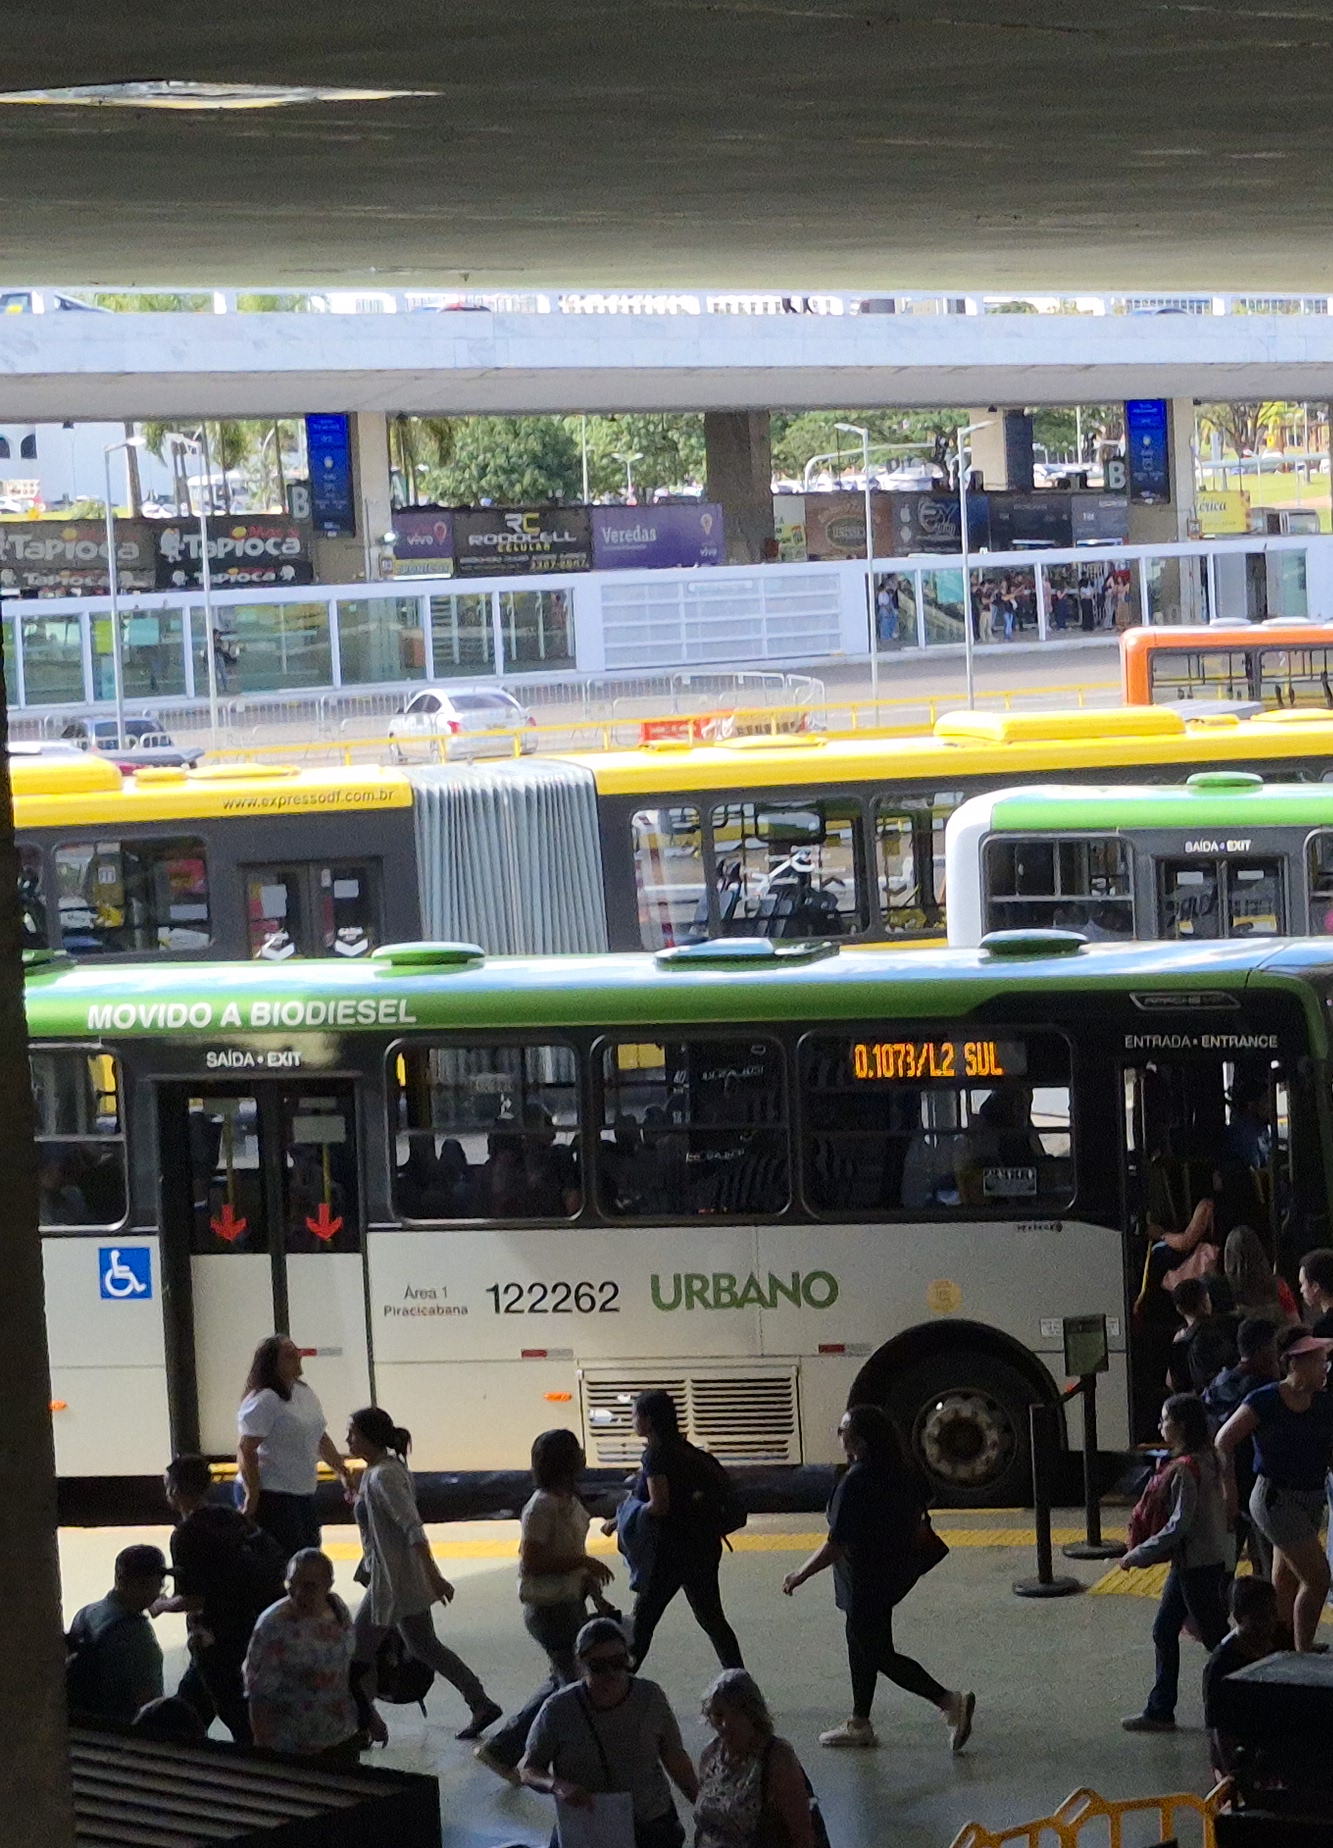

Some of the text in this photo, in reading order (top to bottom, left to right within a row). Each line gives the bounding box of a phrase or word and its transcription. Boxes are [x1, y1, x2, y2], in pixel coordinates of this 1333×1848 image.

[1109, 461, 1126, 489] B
[291, 486, 310, 519] B
[602, 525, 657, 543] Veredas
[222, 788, 394, 810] www.expressodf.com.br
[1185, 839, 1251, 853] SAÍDA EXIT
[88, 999, 418, 1031] MOVIDO A BIODIESEL
[1124, 1034, 1278, 1048] ENTRADA ENTRANCE
[206, 1050, 302, 1069] SAÍDA EXIT
[964, 1041, 1005, 1077] SUL
[404, 1284, 448, 1300] Área 1
[485, 1280, 621, 1315] 122262
[651, 1270, 839, 1312] URBANO
[384, 1304, 469, 1318] Piracicabana
